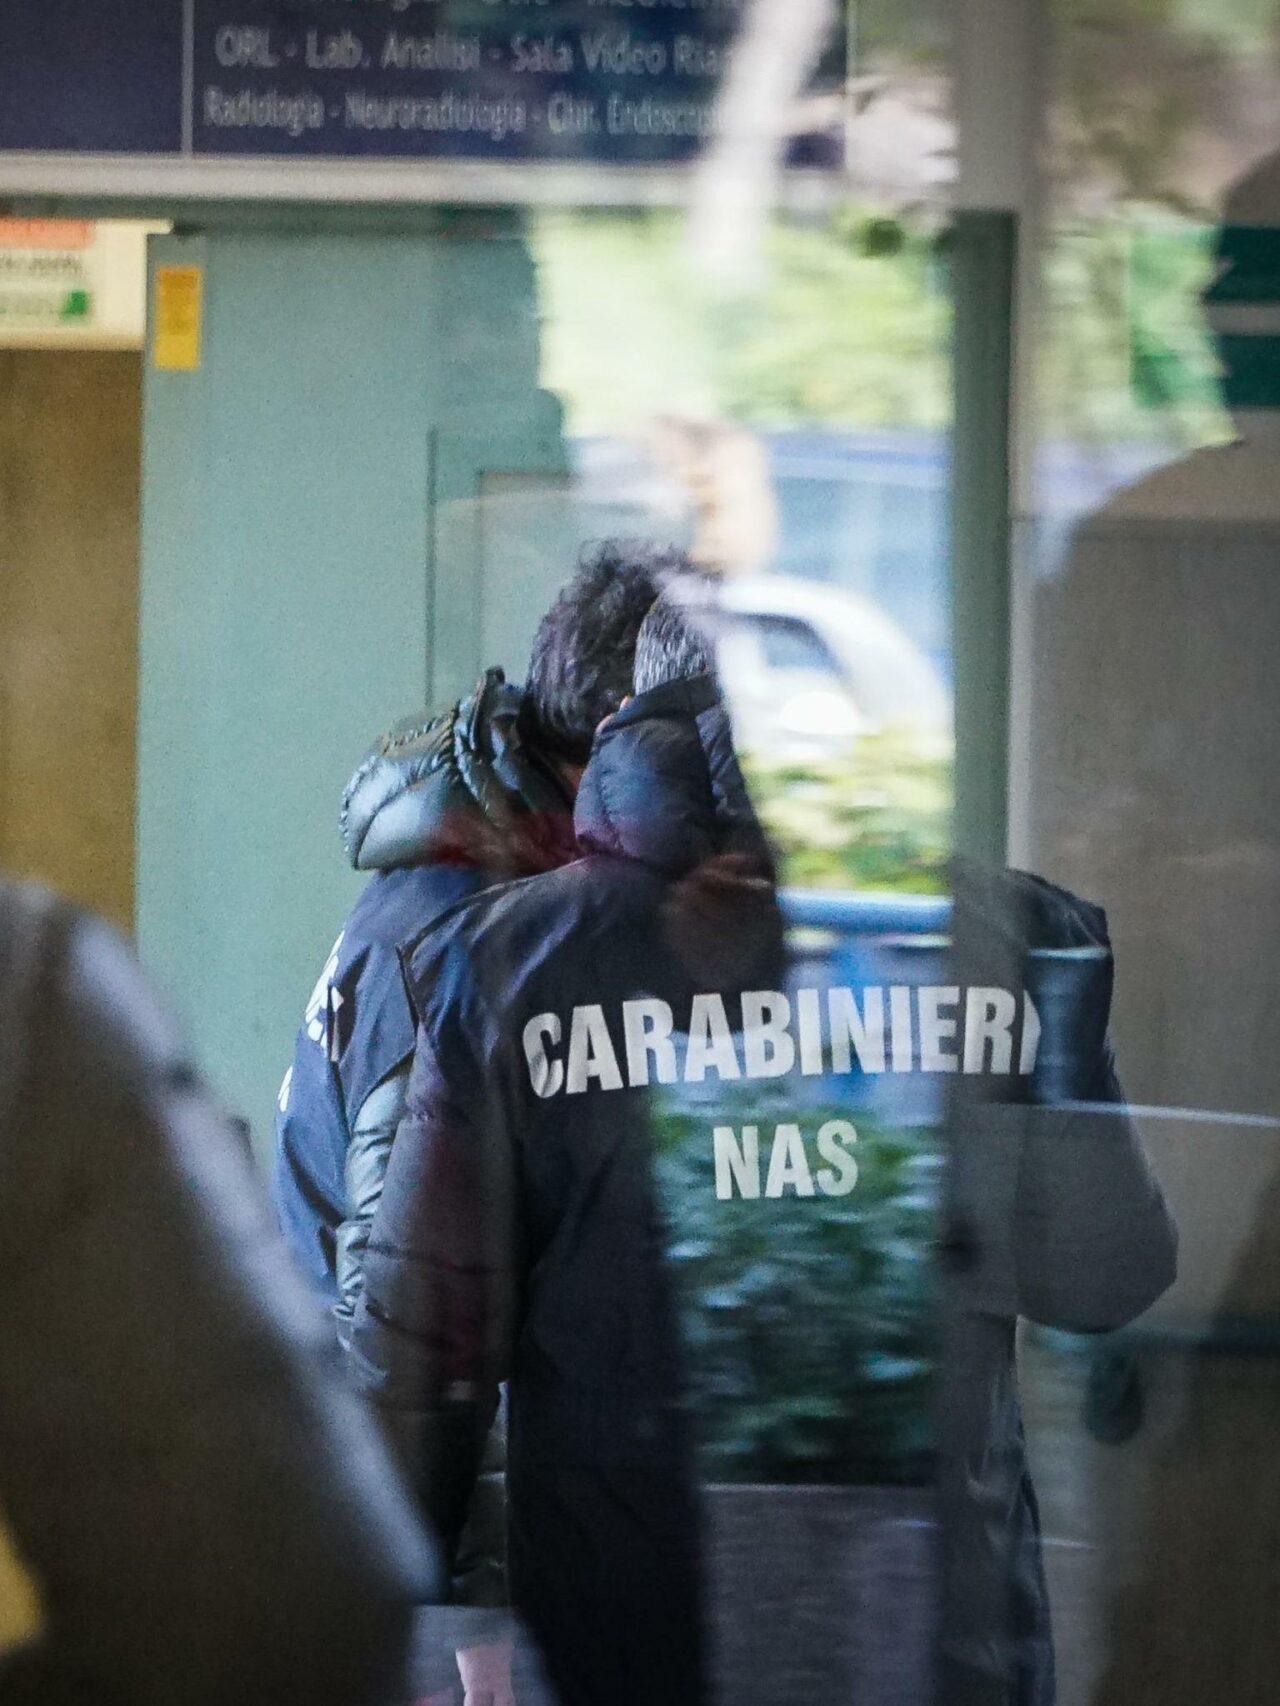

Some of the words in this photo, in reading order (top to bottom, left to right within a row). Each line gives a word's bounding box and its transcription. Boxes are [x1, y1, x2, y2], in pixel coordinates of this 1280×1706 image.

[306, 26, 372, 69] Lab.
[581, 32, 667, 75] Video
[521, 984, 1042, 1098] CARABINIERI
[713, 1119, 859, 1201] NAS
